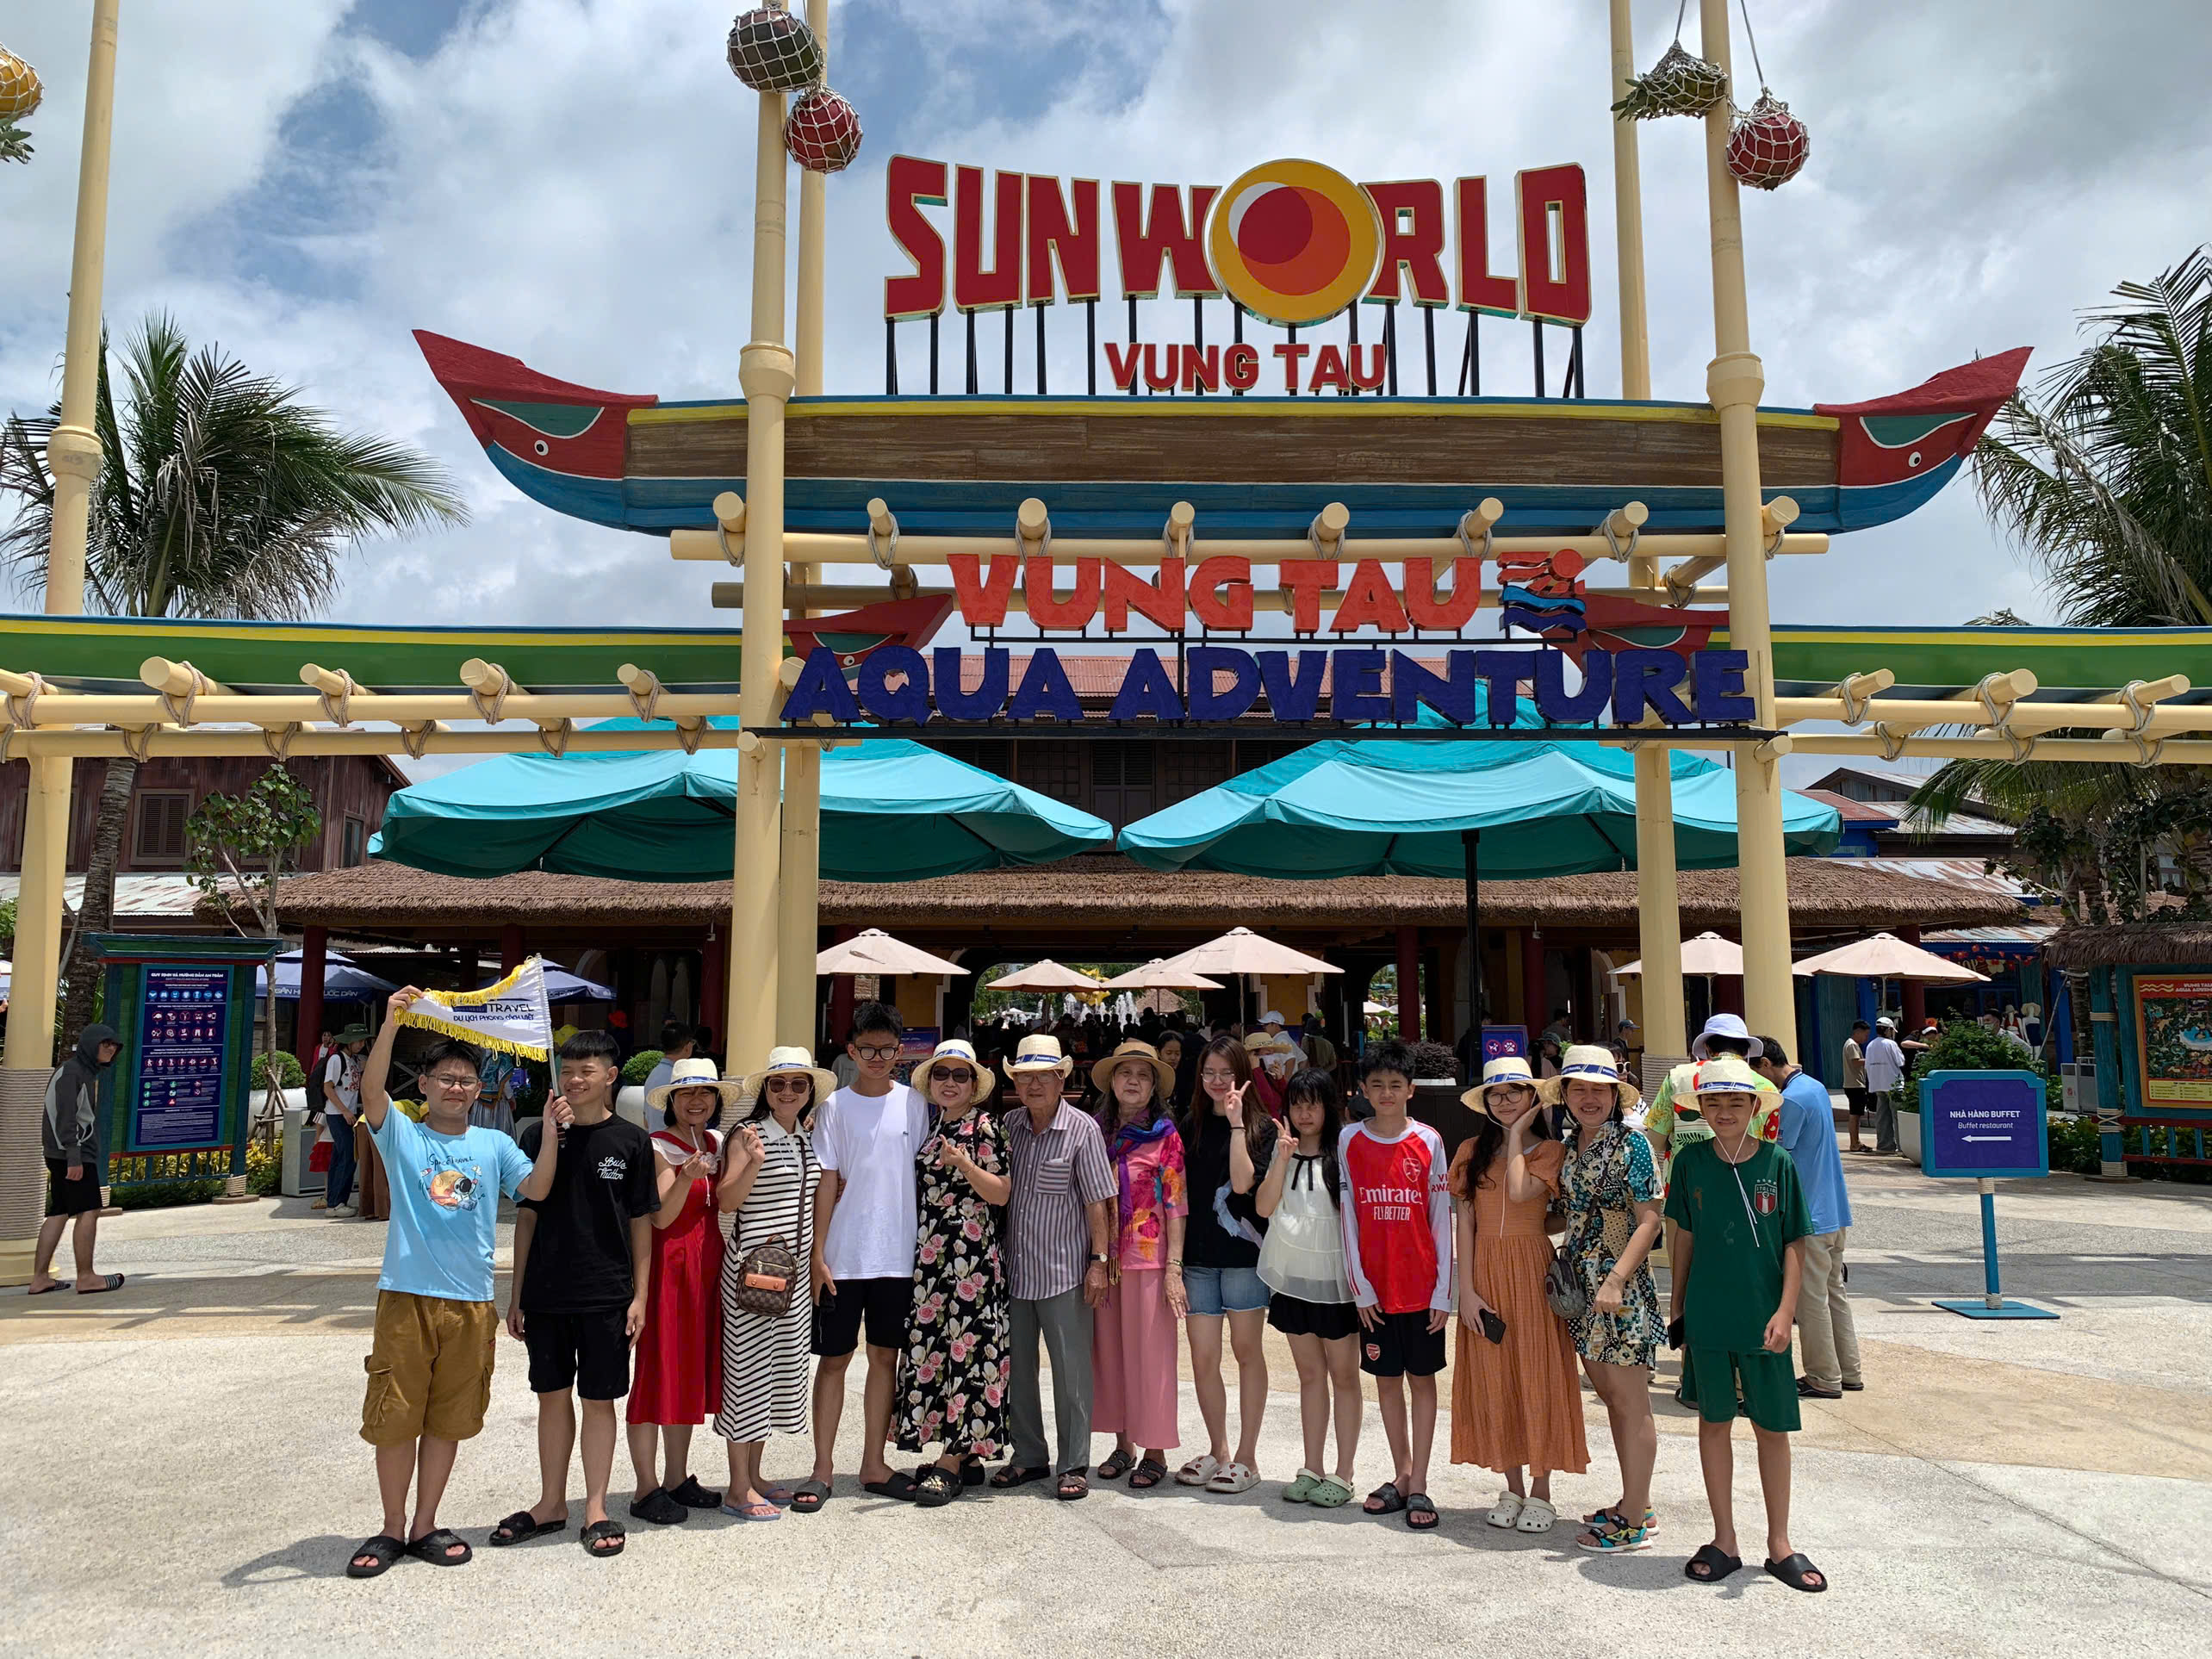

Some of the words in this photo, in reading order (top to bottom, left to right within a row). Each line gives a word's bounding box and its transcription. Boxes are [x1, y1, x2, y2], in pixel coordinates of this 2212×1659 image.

[1104, 342, 1259, 392] VUNG
[1273, 343, 1386, 392] TAU
[948, 554, 1254, 632] VUNG
[1279, 556, 1481, 633] TAU
[779, 645, 1084, 727] AQUA
[1107, 646, 1756, 724] ADVENTURE
[274, 986, 293, 995] GÂN
[487, 1003, 535, 1013] TRAVEL
[1949, 1109, 1967, 1118] NHÀ
[1967, 1109, 1990, 1118] HÀNG
